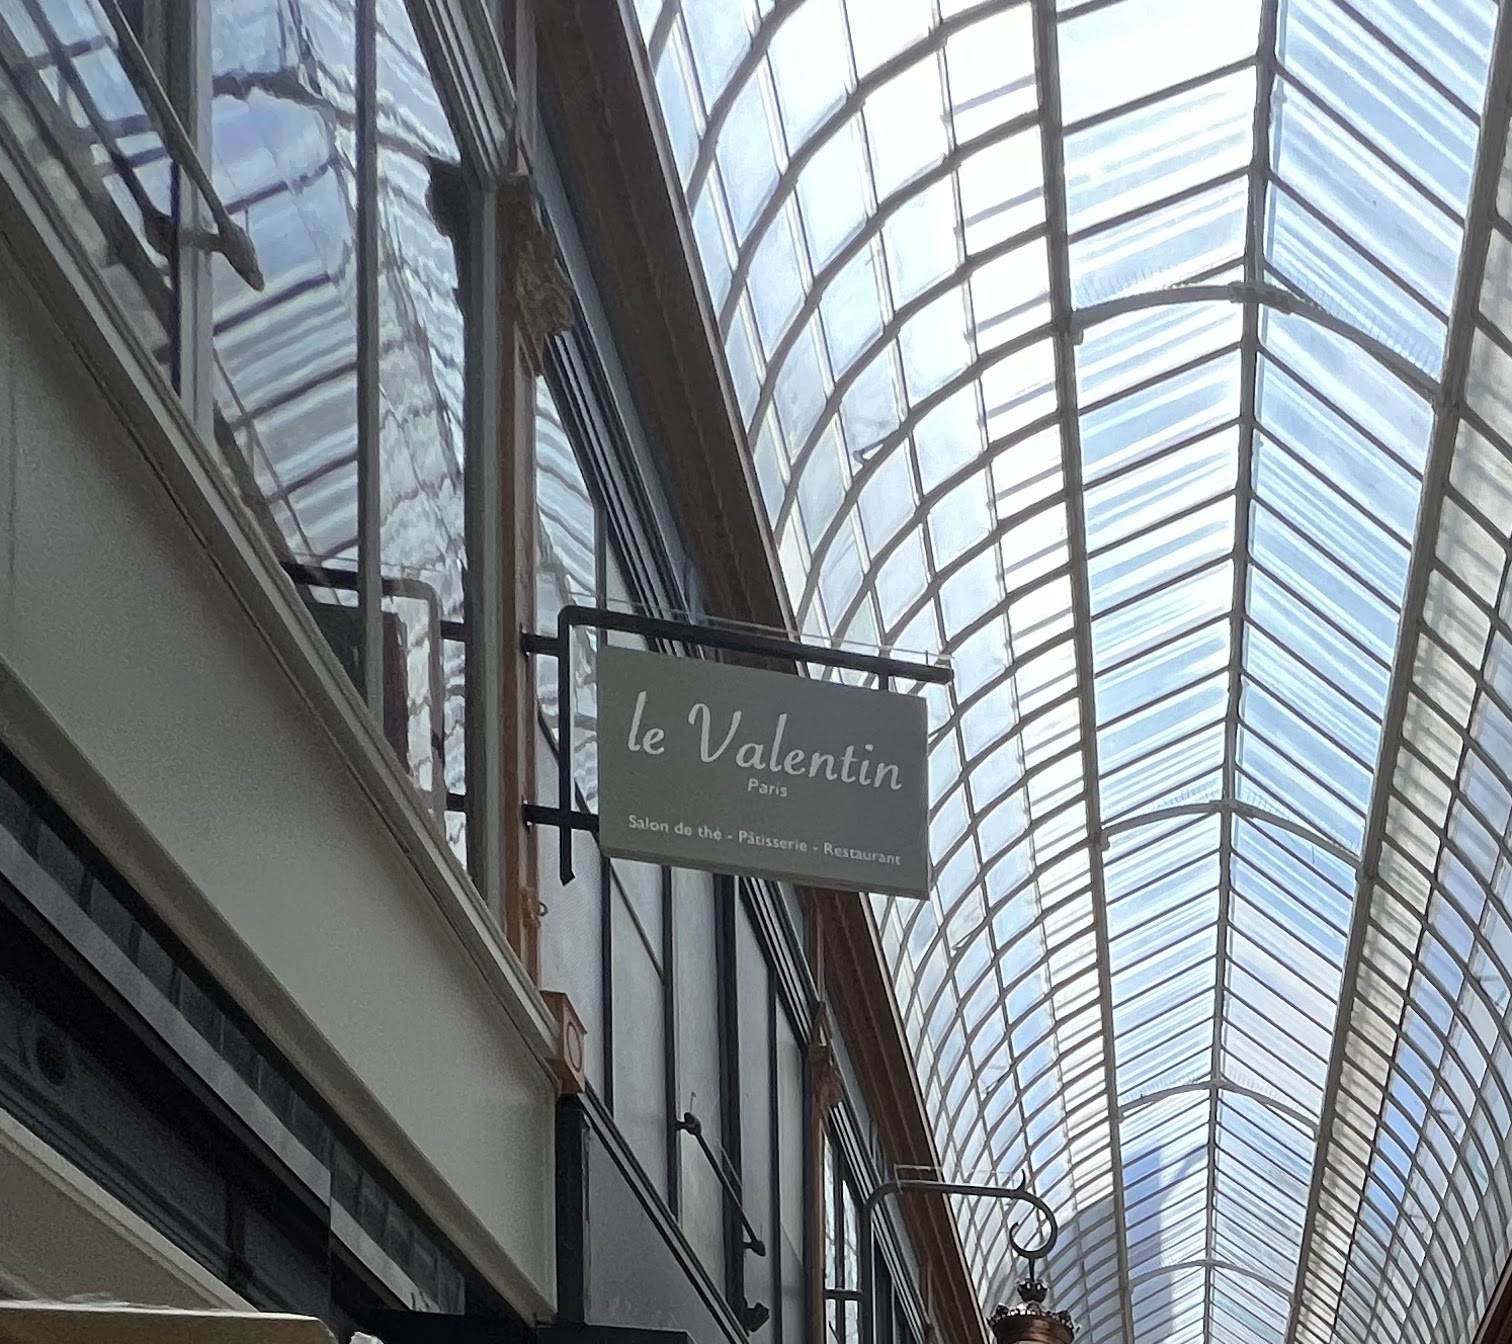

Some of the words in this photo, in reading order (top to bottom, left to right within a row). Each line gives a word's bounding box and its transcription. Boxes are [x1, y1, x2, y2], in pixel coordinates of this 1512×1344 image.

[627, 690, 665, 755] le
[688, 702, 903, 791] Valentin
[747, 778, 788, 798] Paris
[628, 814, 669, 835] Salon
[674, 821, 693, 837] de
[698, 823, 722, 841] thé
[738, 829, 808, 853] Pâtisserie
[824, 842, 902, 867] Restaurant
